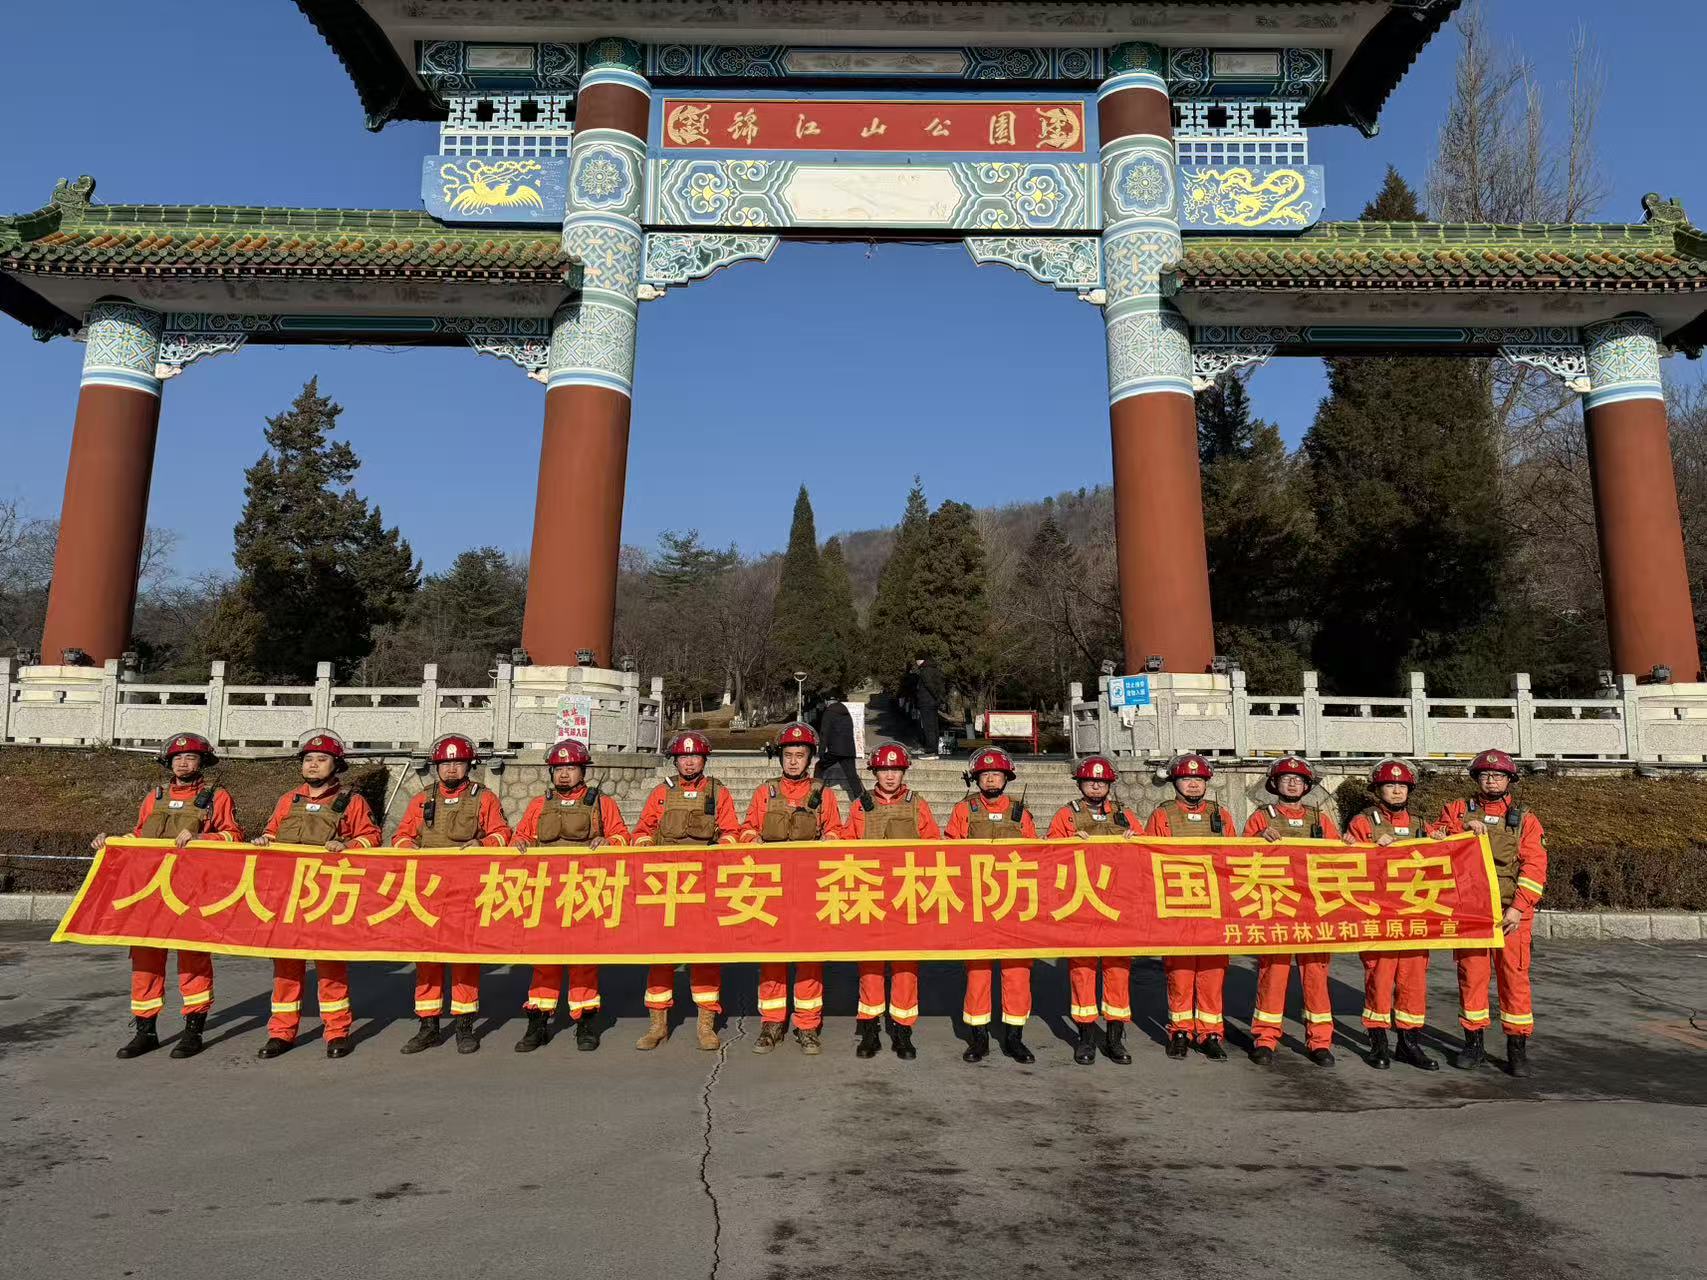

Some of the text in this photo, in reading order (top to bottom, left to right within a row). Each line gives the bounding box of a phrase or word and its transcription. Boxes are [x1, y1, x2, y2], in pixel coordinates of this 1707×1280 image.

[111, 849, 1457, 929] 人人防火 树树平安 森林防火 国泰民安
[1223, 918, 1461, 945] 丹东市林业和草原局 宣
